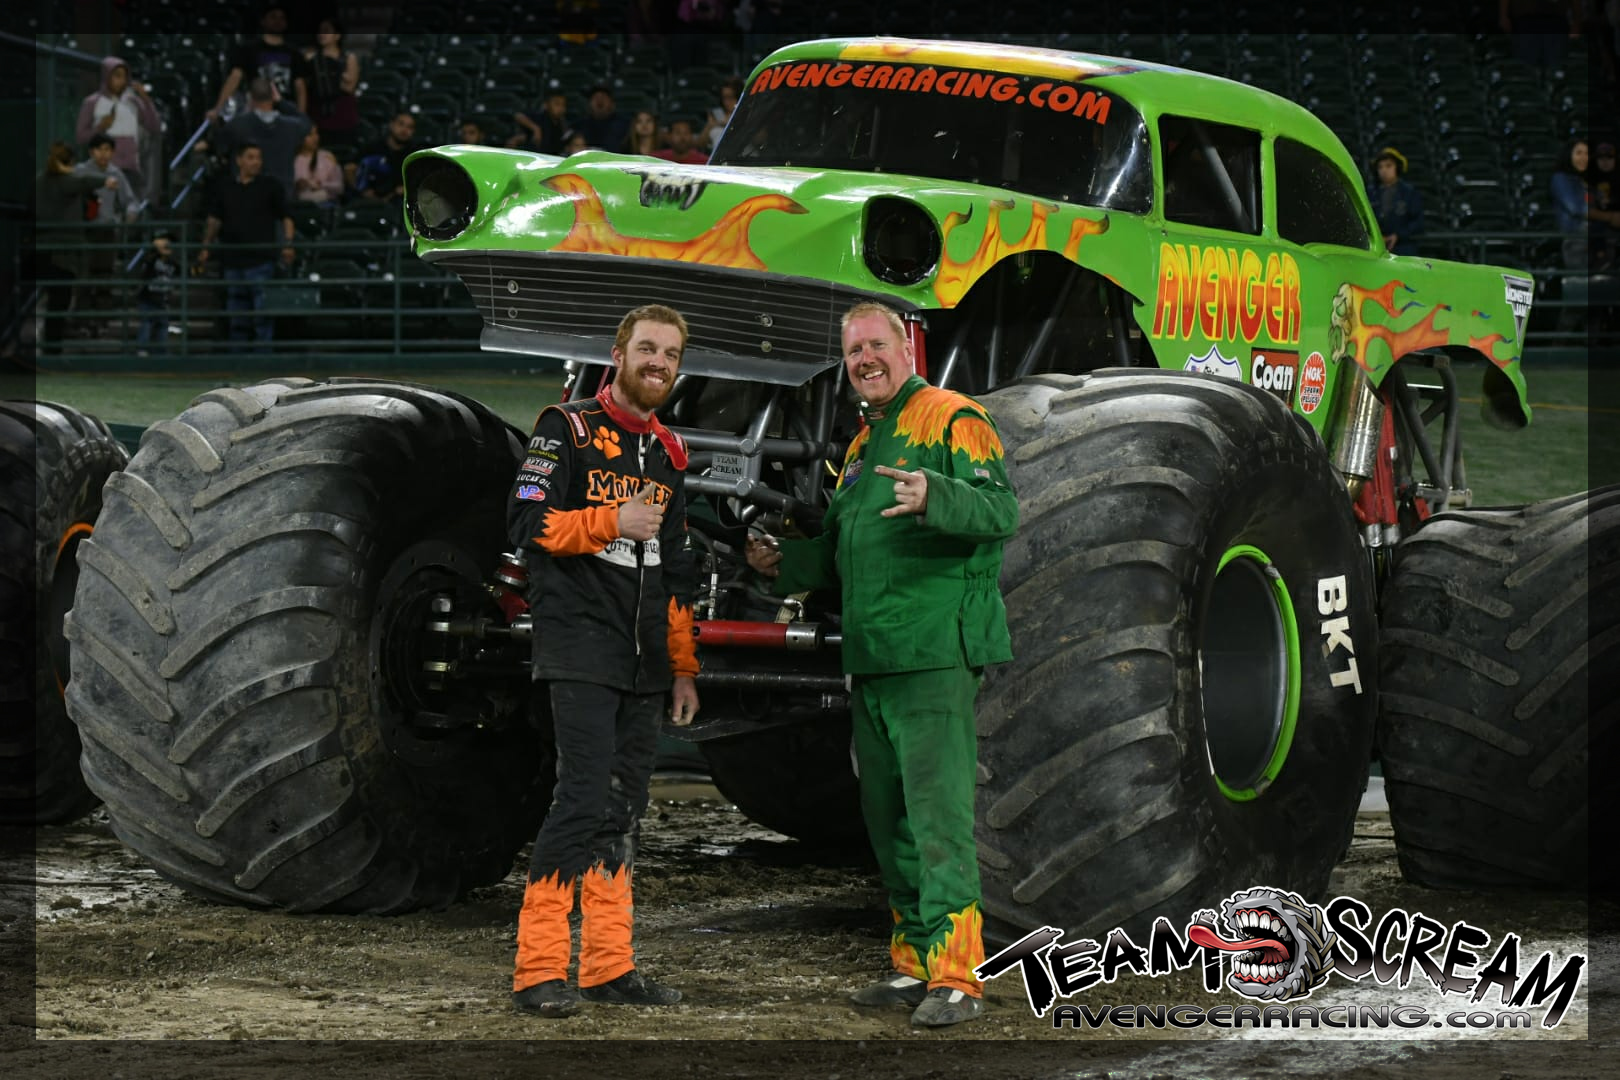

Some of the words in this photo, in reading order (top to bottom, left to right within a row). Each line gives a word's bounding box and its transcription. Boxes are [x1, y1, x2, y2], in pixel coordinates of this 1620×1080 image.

[750, 63, 1112, 125] AVENGERRACING.COM
[1152, 242, 1302, 344] AVENGER
[1252, 355, 1294, 391] Coan
[1304, 367, 1323, 382] NGK
[1303, 386, 1321, 395] SPARK
[711, 465, 742, 476] SCREAM
[717, 455, 738, 465] TEAM
[517, 474, 539, 482] LUCAS
[586, 469, 672, 512] MONER
[1317, 575, 1363, 695] BKT
